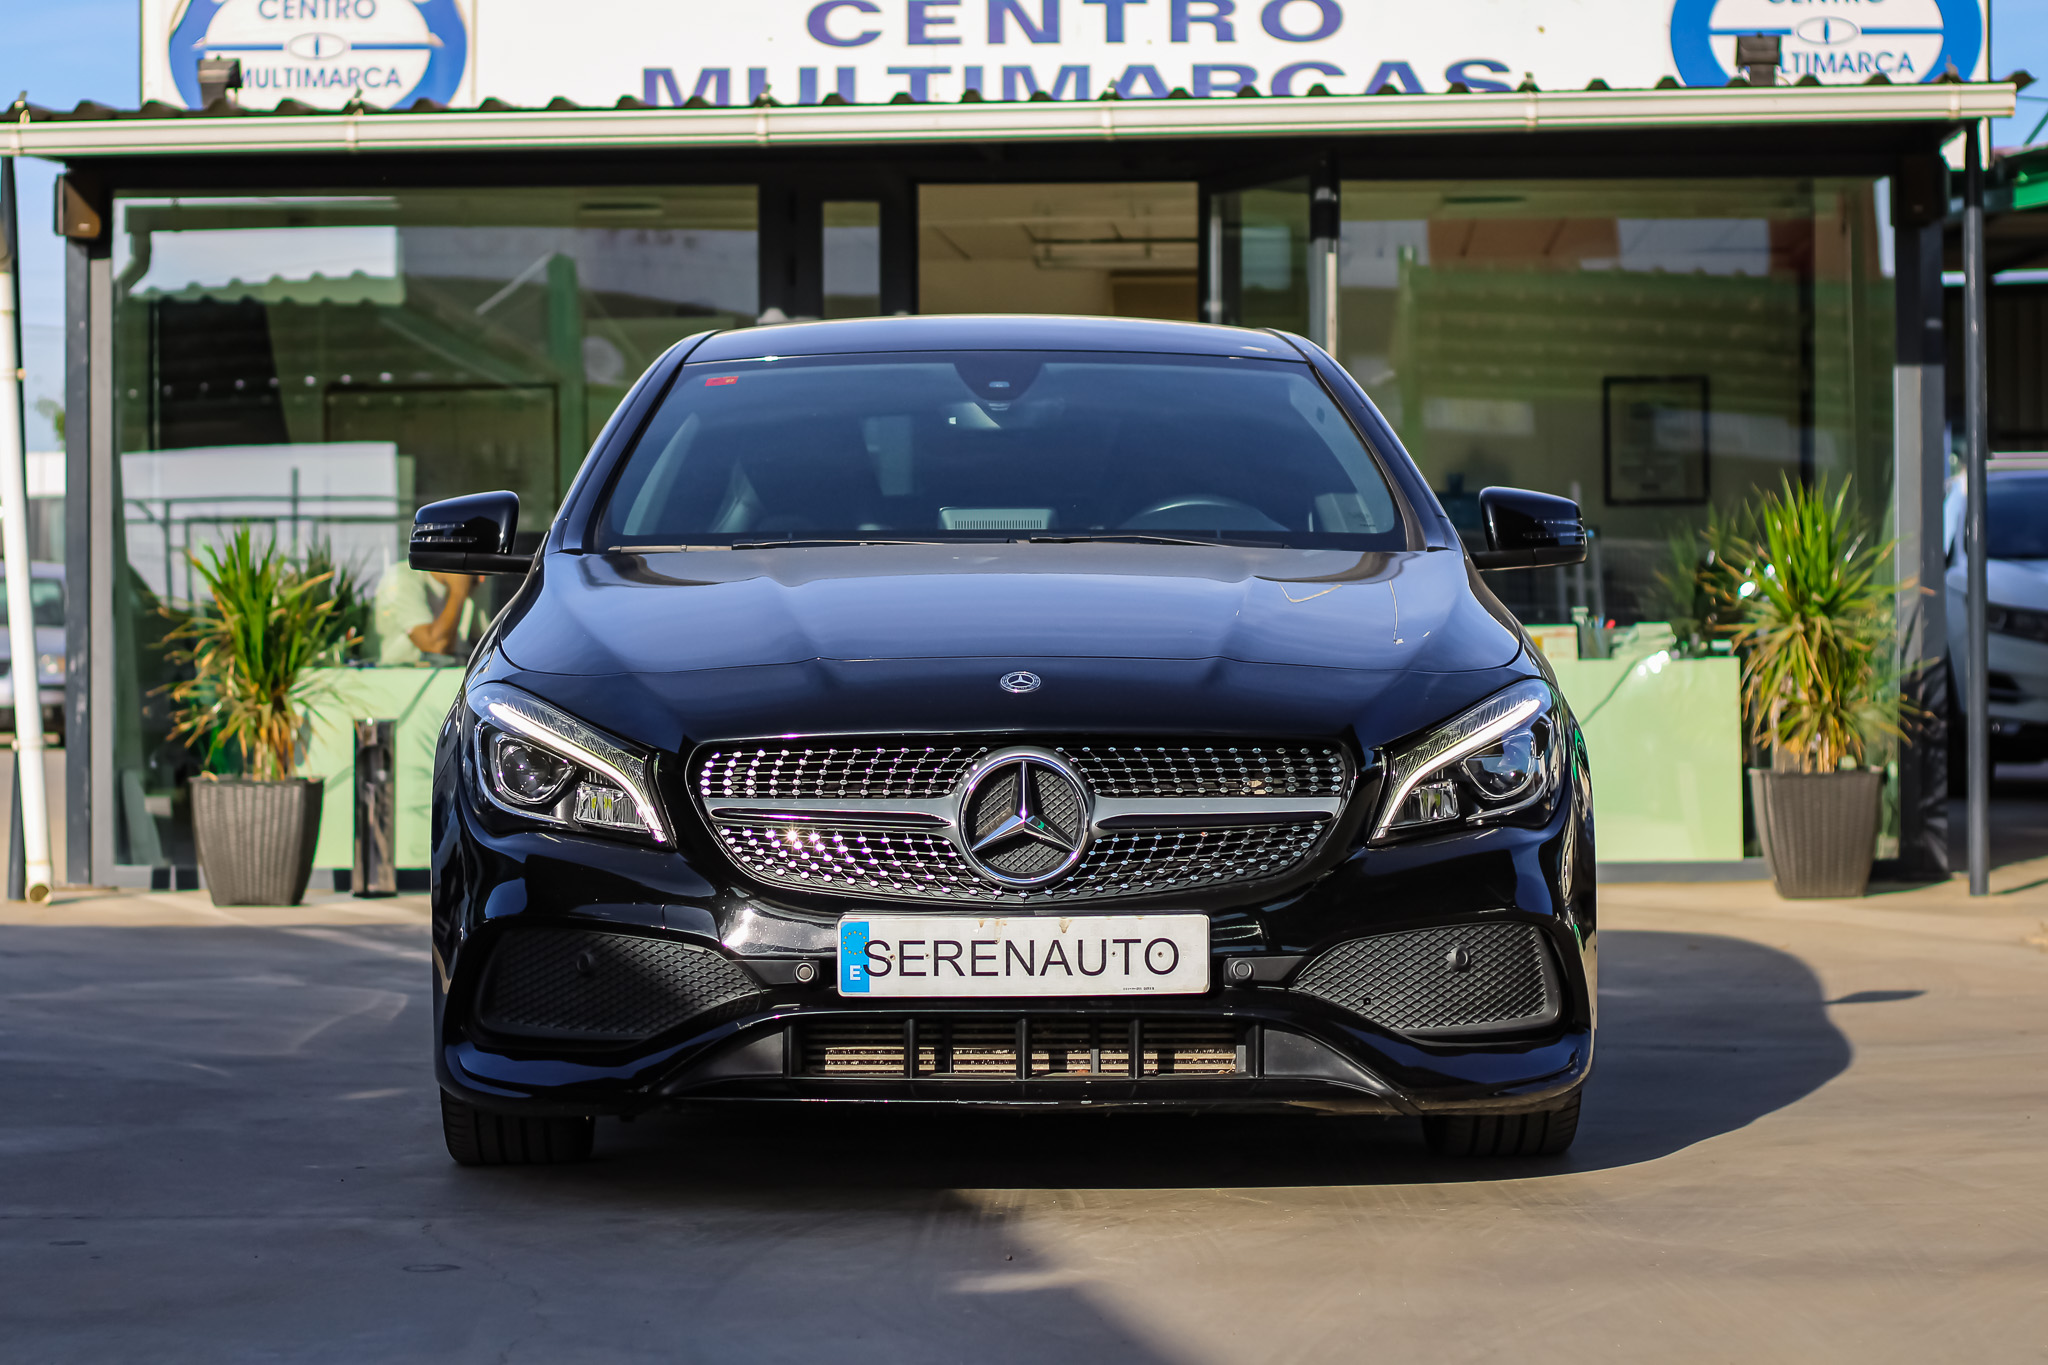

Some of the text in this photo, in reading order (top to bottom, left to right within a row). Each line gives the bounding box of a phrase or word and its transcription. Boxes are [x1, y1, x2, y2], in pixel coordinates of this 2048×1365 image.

[258, 0, 376, 19] CENTRO
[805, 0, 1344, 47] CENTRO
[1778, 51, 1915, 74] LTIMARCA
[863, 937, 1180, 977] SERENAUTO
[849, 965, 861, 981] E
